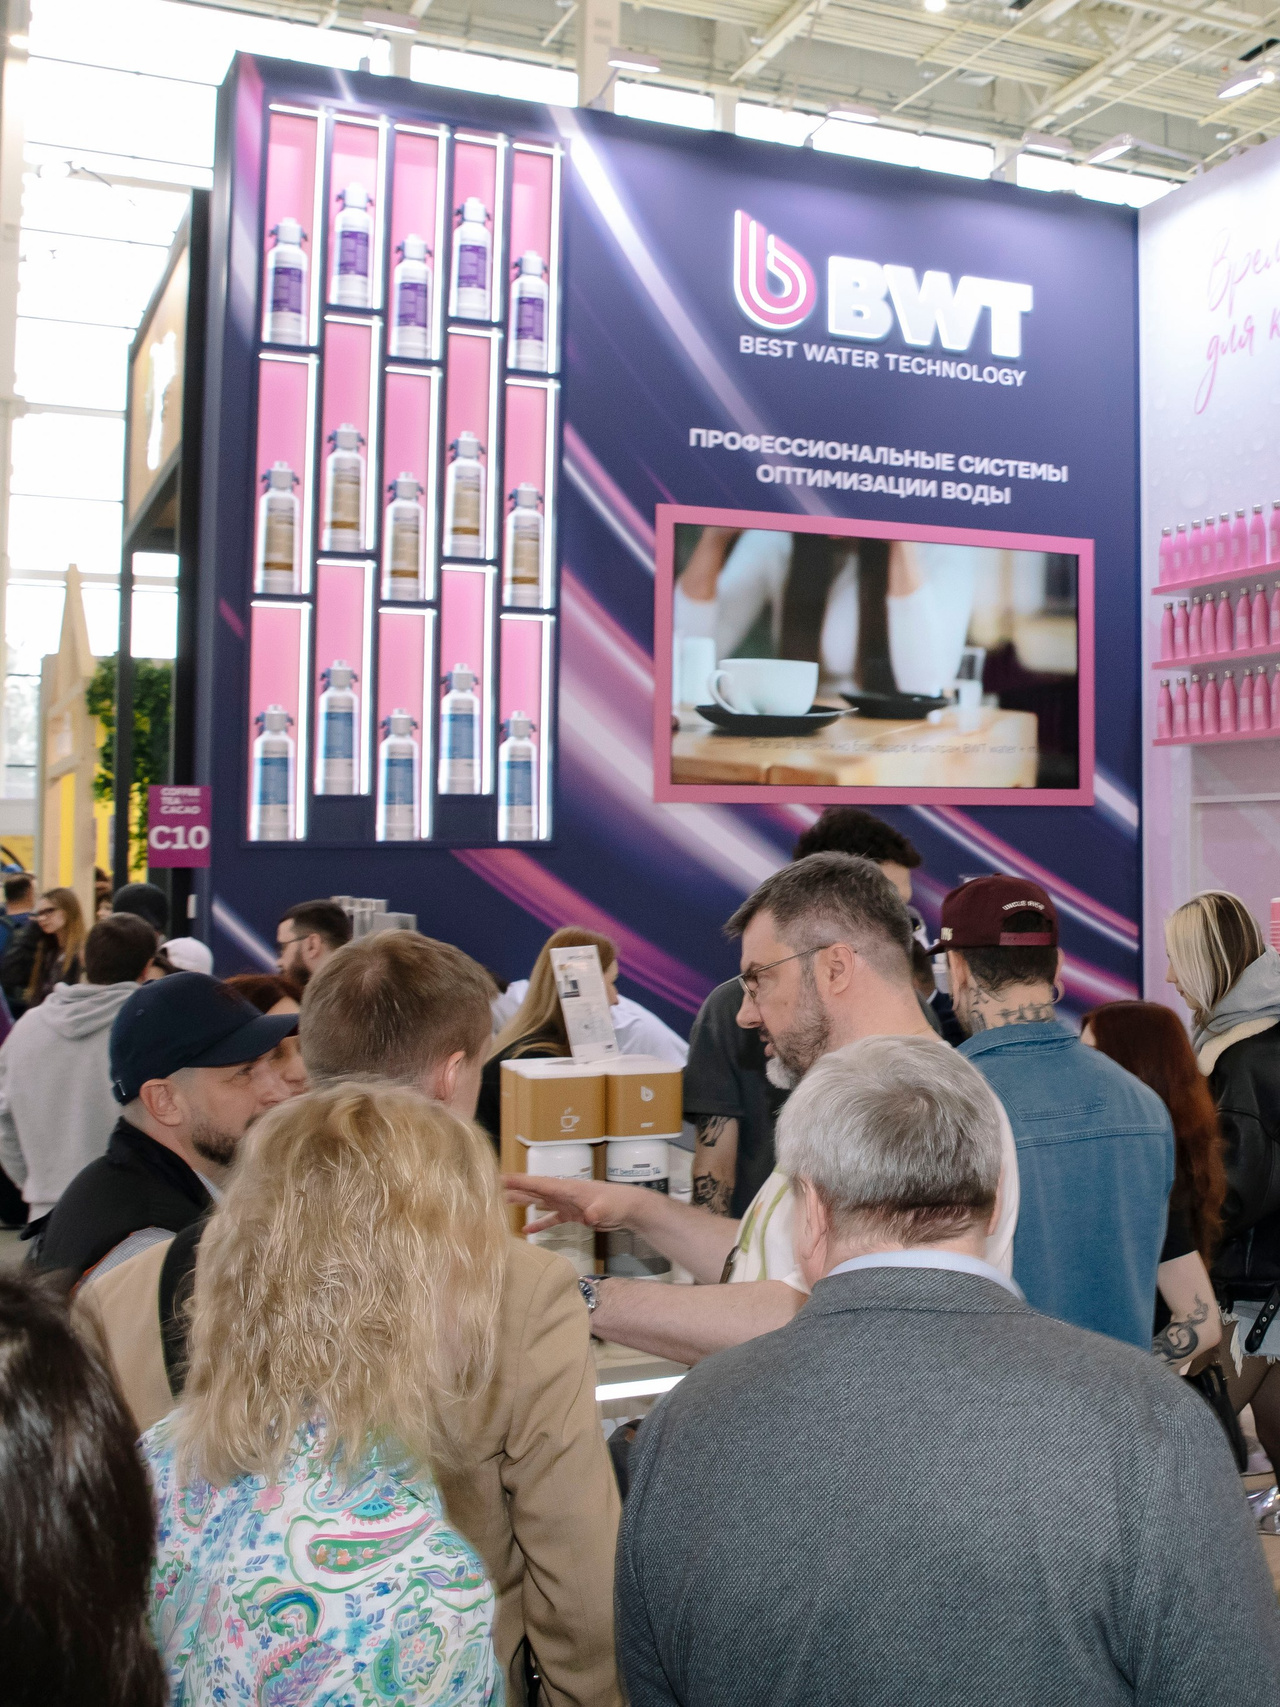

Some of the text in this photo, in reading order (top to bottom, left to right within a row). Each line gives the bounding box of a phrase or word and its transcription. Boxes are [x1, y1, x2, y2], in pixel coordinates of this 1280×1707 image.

[828, 255, 1033, 358] BWT
[739, 335, 1027, 387] BEST WATER TECHNOLOGY
[1194, 314, 1254, 415] для
[689, 428, 1069, 483] ПРОФЕССИОНАЛЬНЫЕ СИСТЕМЫ
[756, 464, 1011, 505] ОПТИМИЗАЦИИ ВОДЫ
[149, 824, 210, 850] C10
